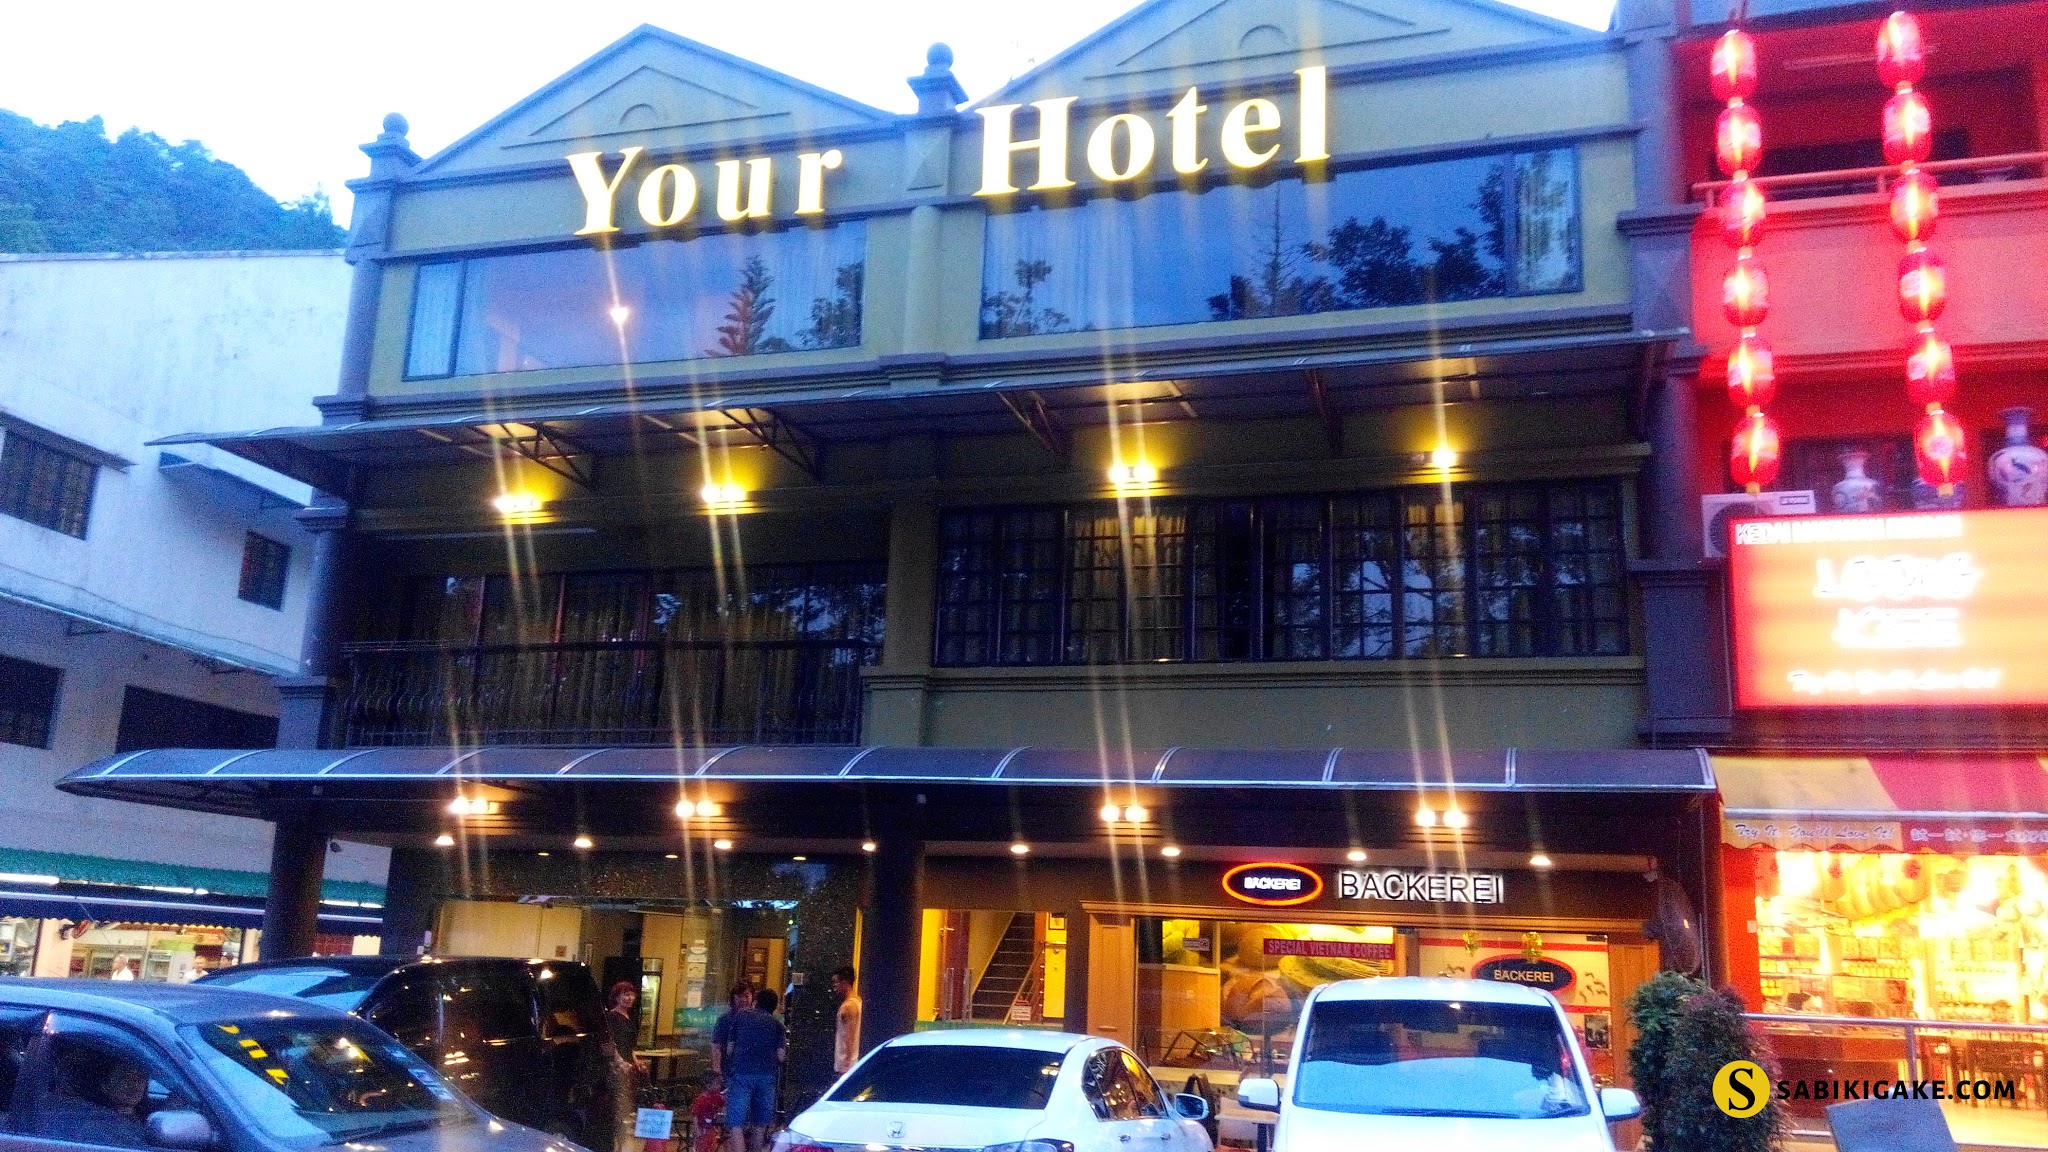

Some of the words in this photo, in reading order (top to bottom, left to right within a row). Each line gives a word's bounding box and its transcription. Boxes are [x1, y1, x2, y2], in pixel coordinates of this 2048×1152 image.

[565, 144, 844, 236] Your
[973, 64, 1330, 197] Hotel
[1268, 940, 1307, 955] SPECIAL
[1310, 941, 1352, 957] VIETNAM
[1354, 944, 1391, 959] COFFEE
